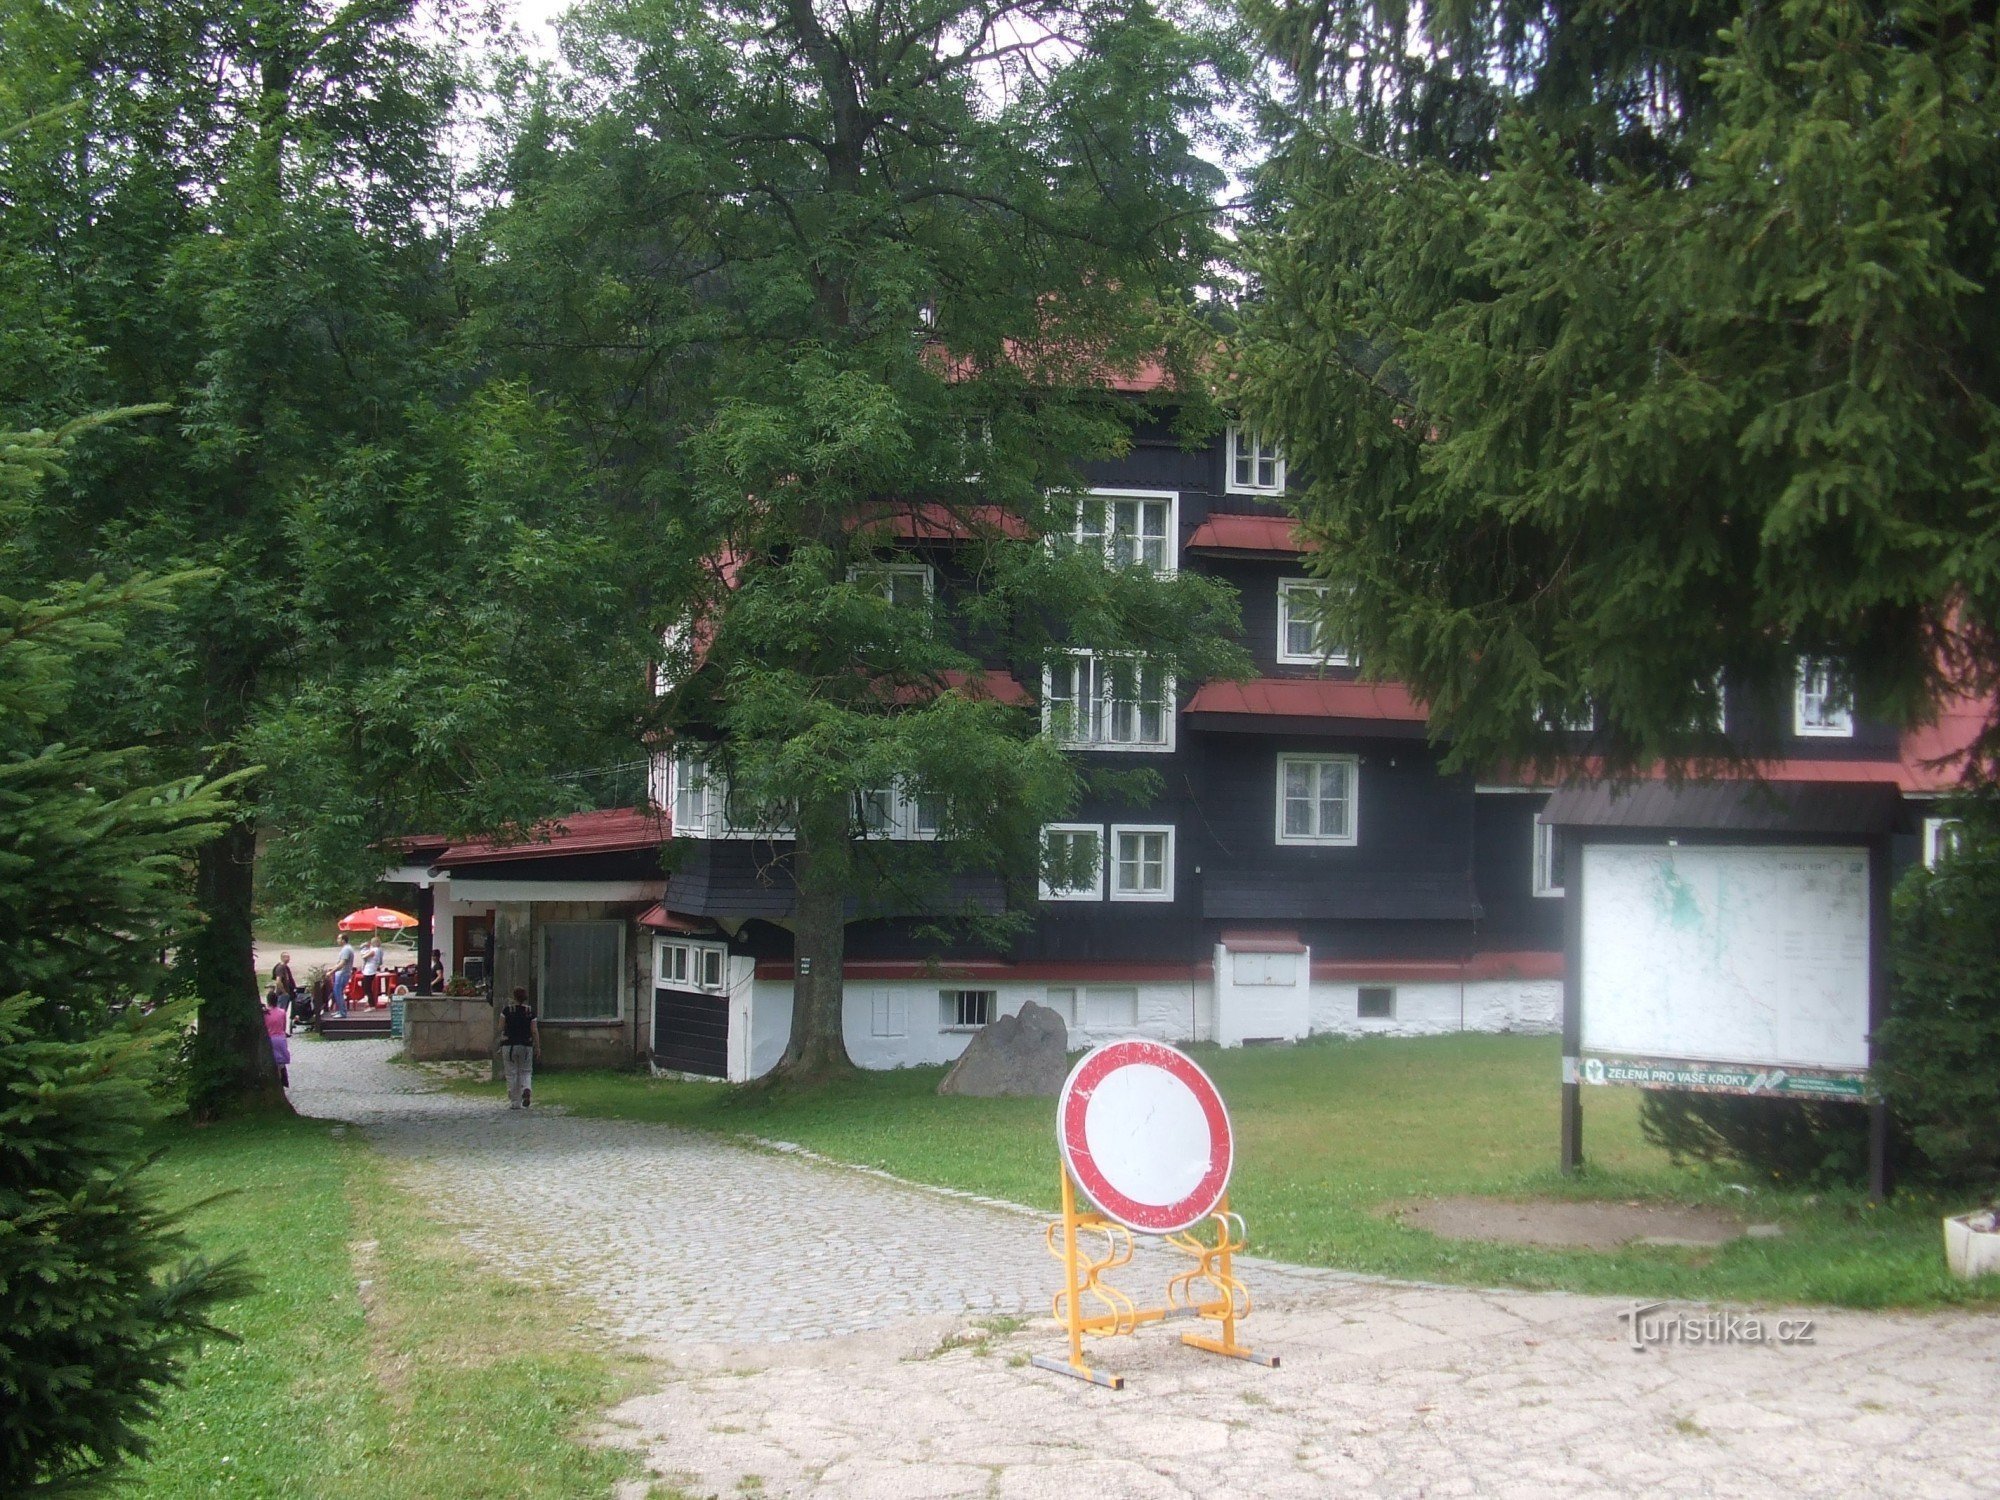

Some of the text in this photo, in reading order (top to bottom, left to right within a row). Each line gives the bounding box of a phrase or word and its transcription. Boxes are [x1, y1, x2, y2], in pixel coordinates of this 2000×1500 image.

[1651, 1070, 1675, 1082] PRO
[1677, 1070, 1707, 1084] VAŠE
[1708, 1073, 1748, 1086] KROKY
